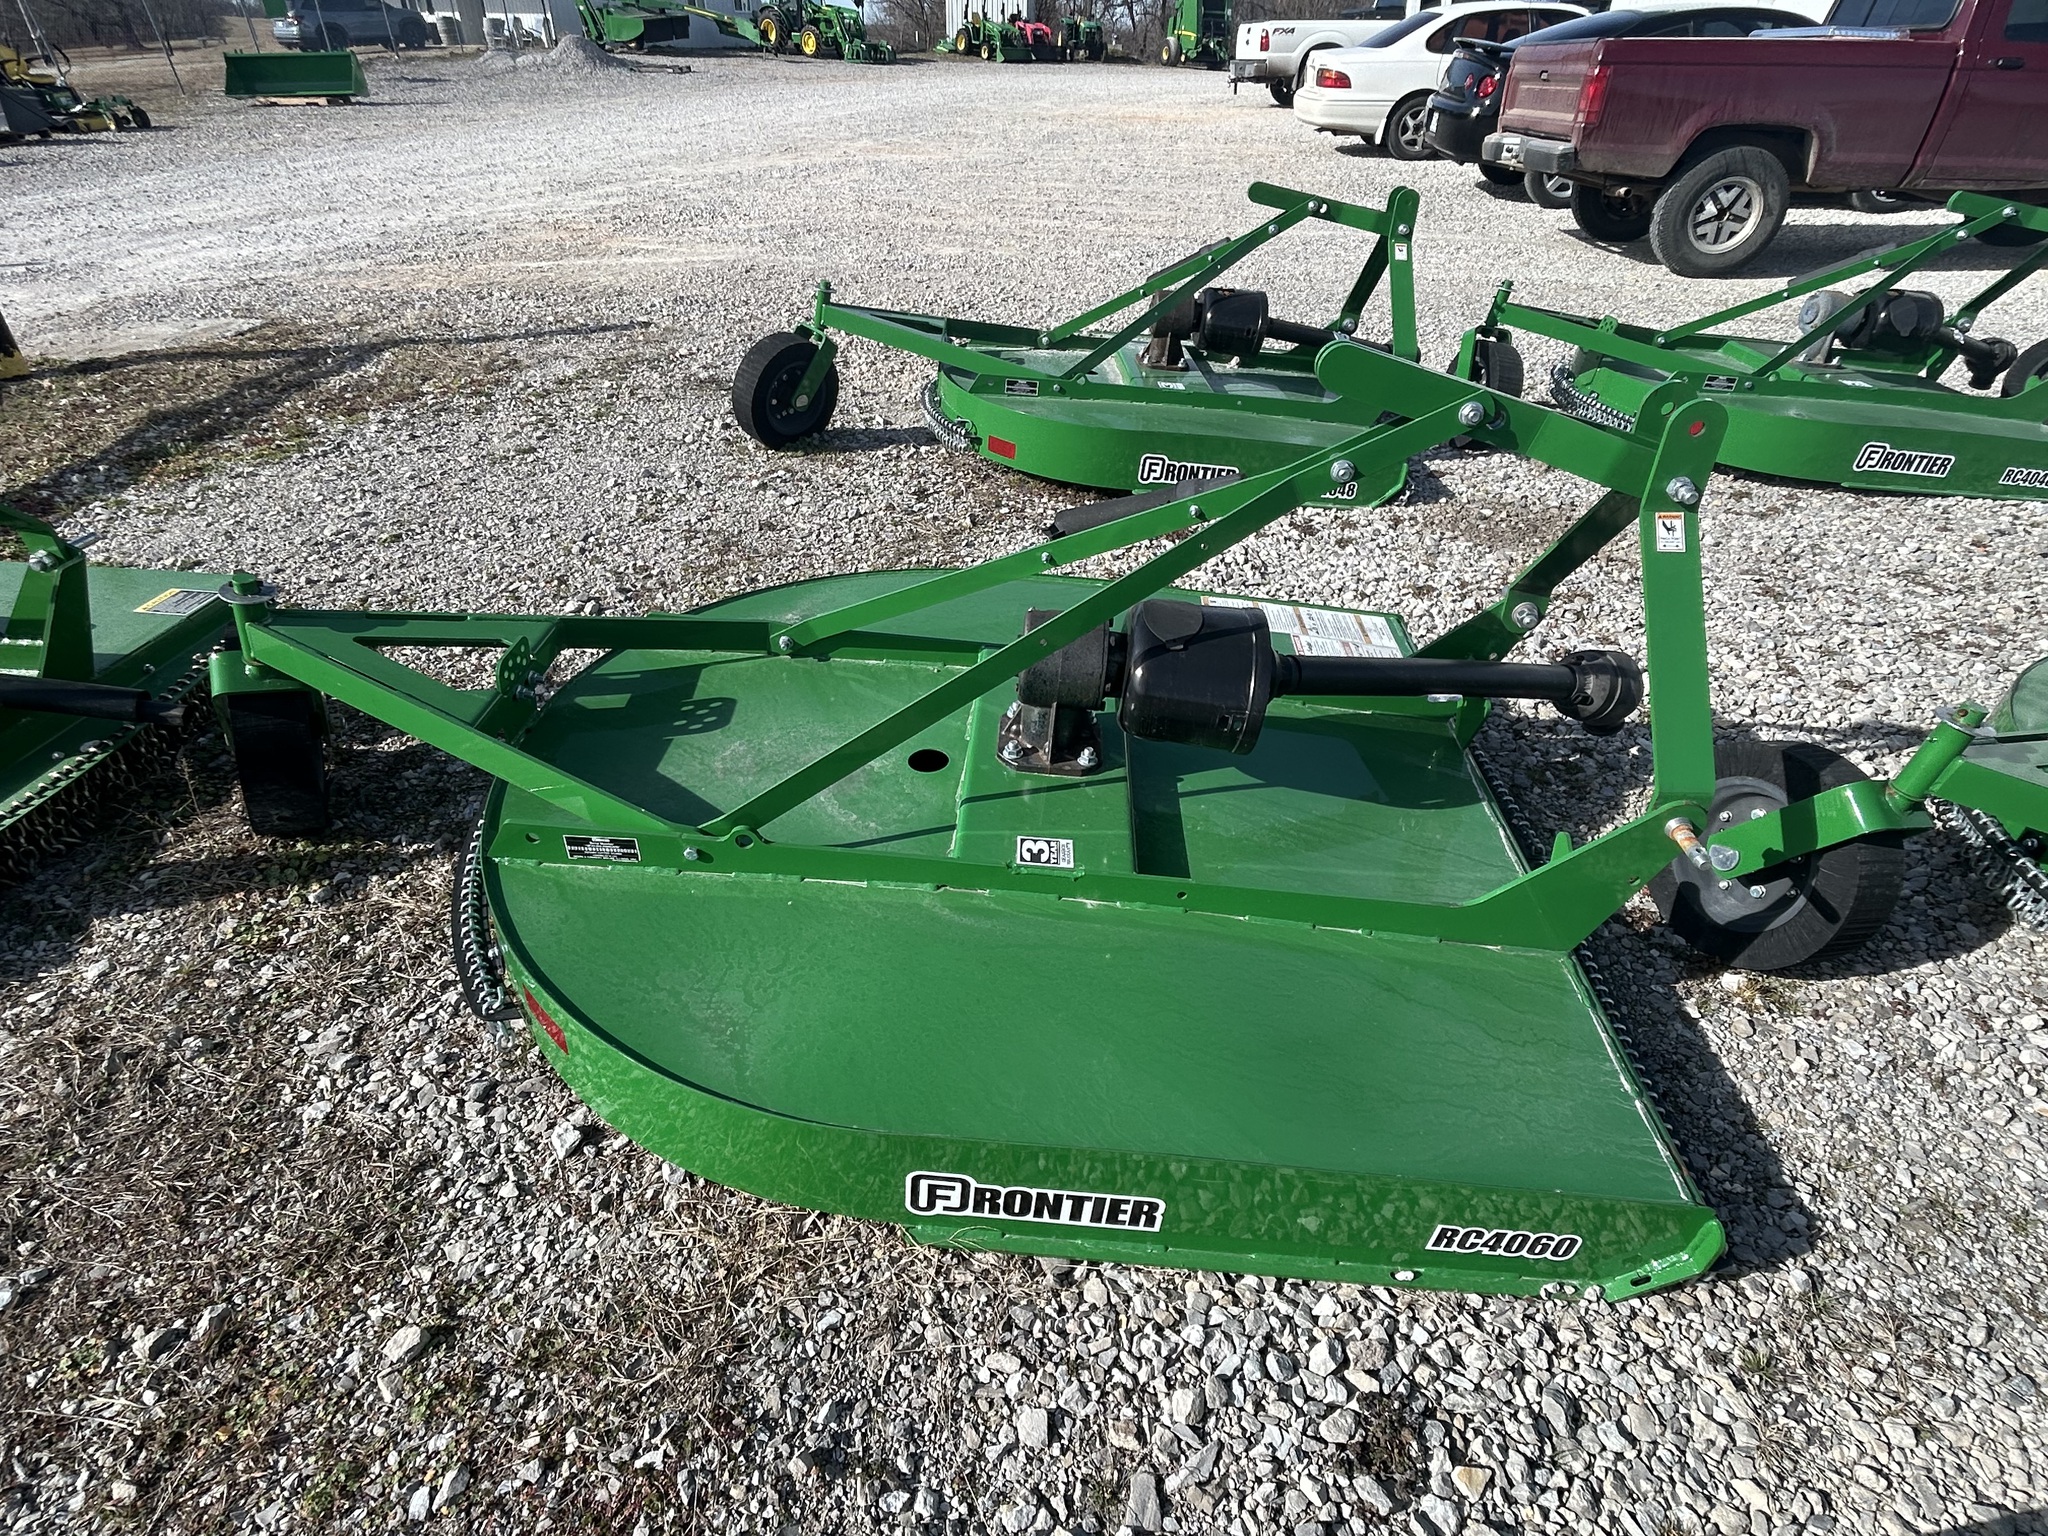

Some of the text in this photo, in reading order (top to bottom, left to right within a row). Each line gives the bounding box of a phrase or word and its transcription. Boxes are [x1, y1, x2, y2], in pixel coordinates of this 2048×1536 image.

[1272, 27, 1296, 36] FX4
[1855, 444, 1953, 476] FRONTIER
[2001, 468, 2048, 487] RC404
[1022, 839, 1050, 863] 3
[910, 1174, 1160, 1229] FRONTIER
[1431, 1227, 1579, 1258] RC4060
